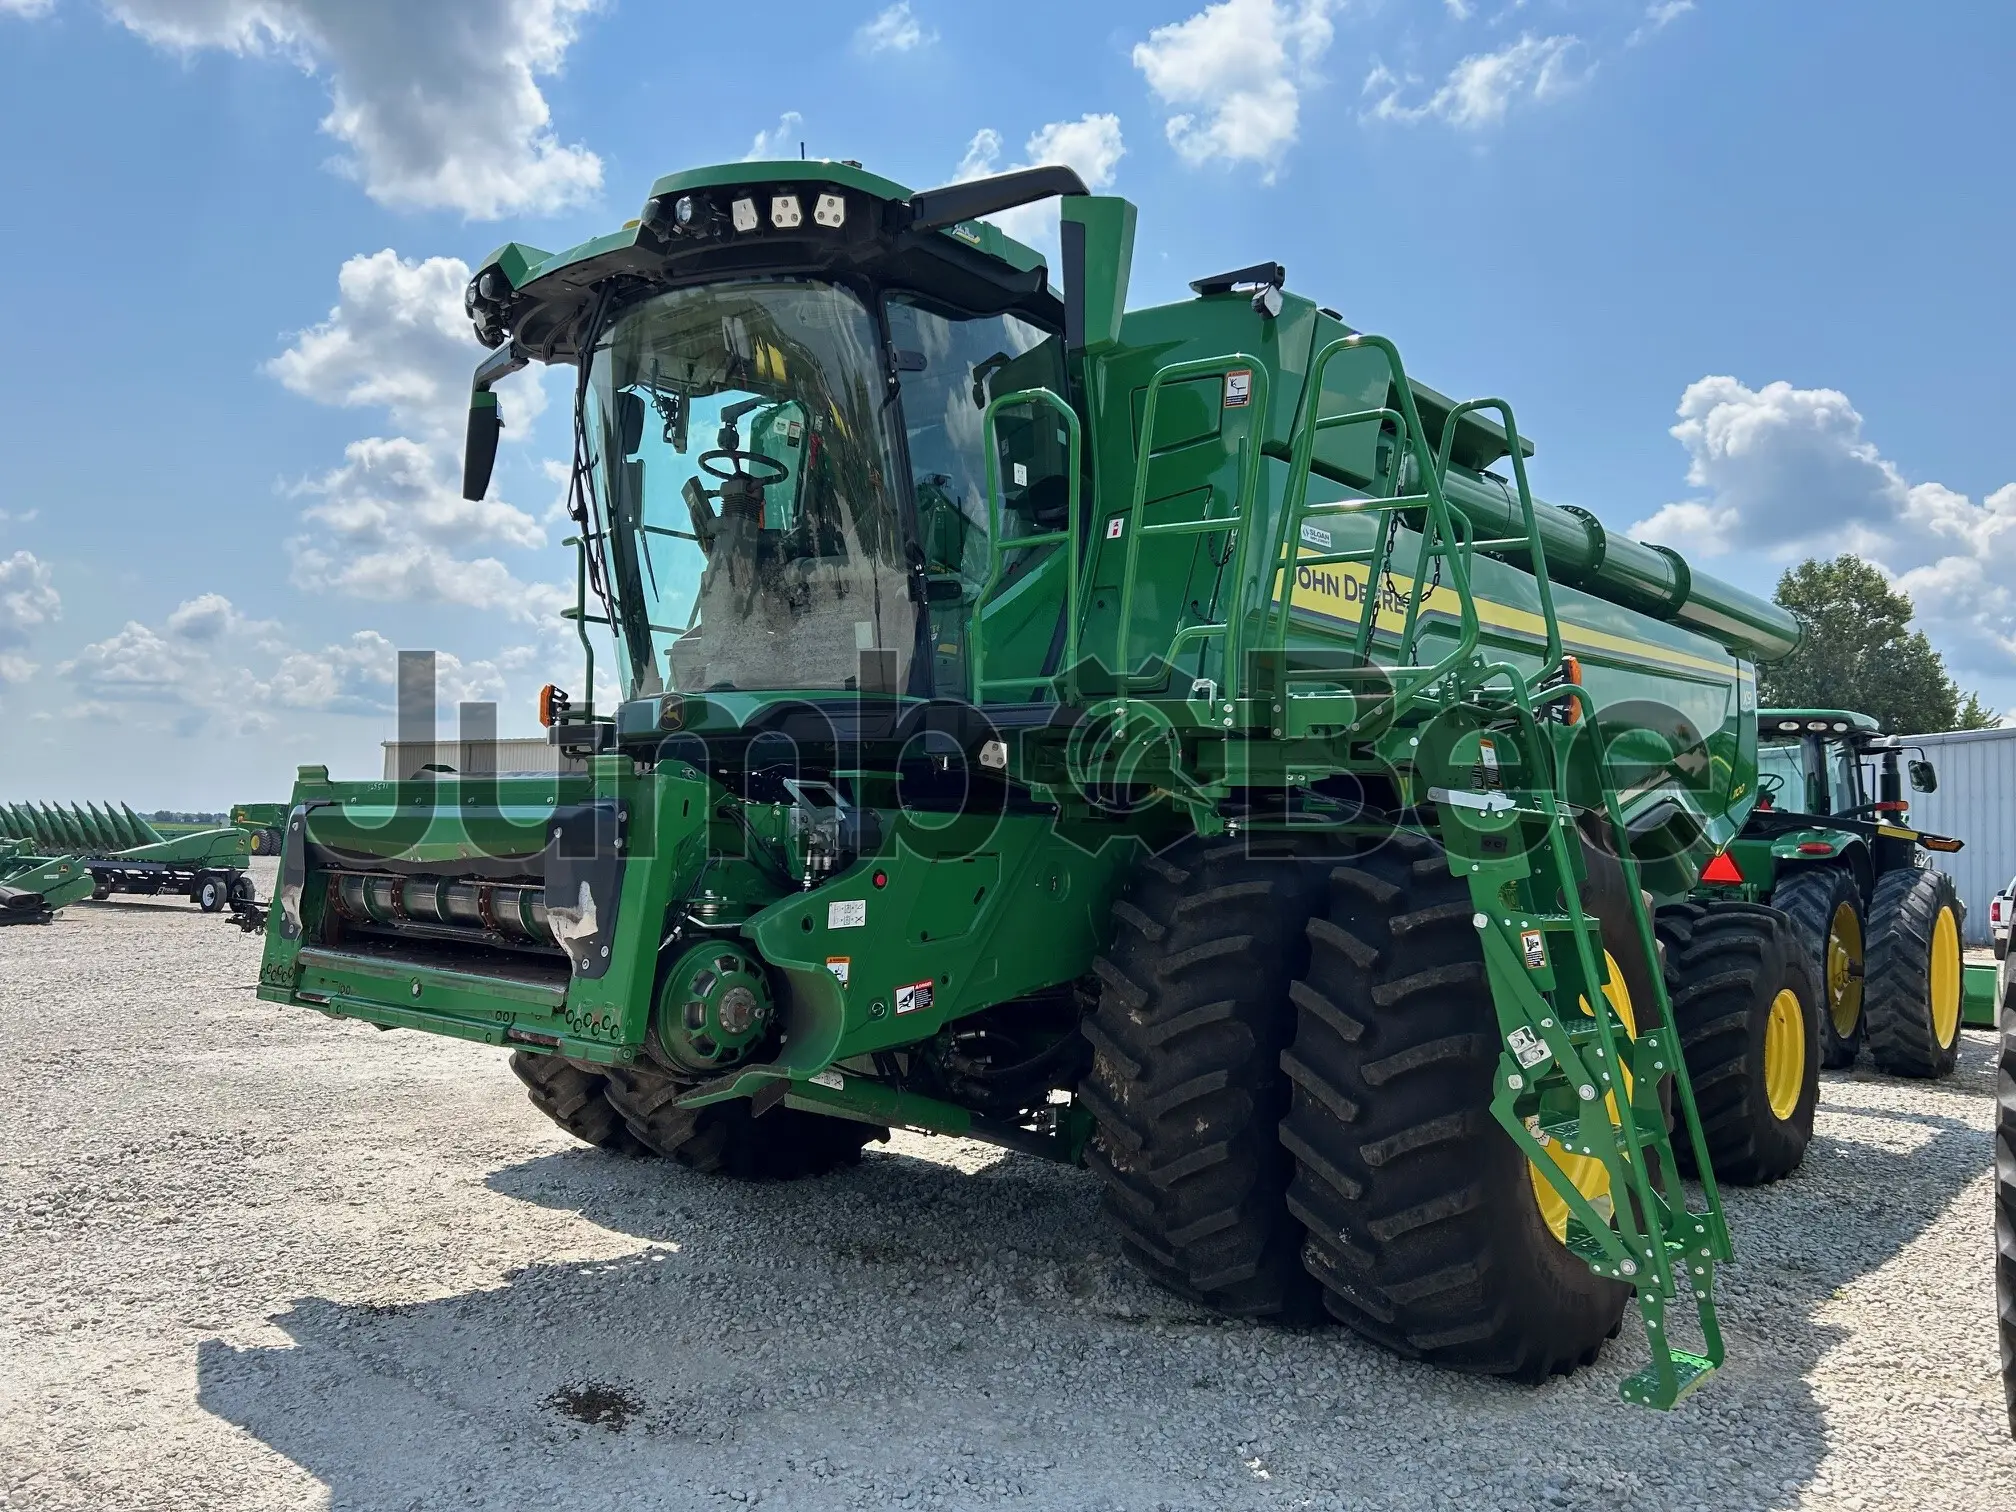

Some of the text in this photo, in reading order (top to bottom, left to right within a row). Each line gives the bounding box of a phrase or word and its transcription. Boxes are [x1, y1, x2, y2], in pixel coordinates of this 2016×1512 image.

[1309, 527, 1330, 541] SLOAN
[1291, 565, 1406, 616] OHN DERE
